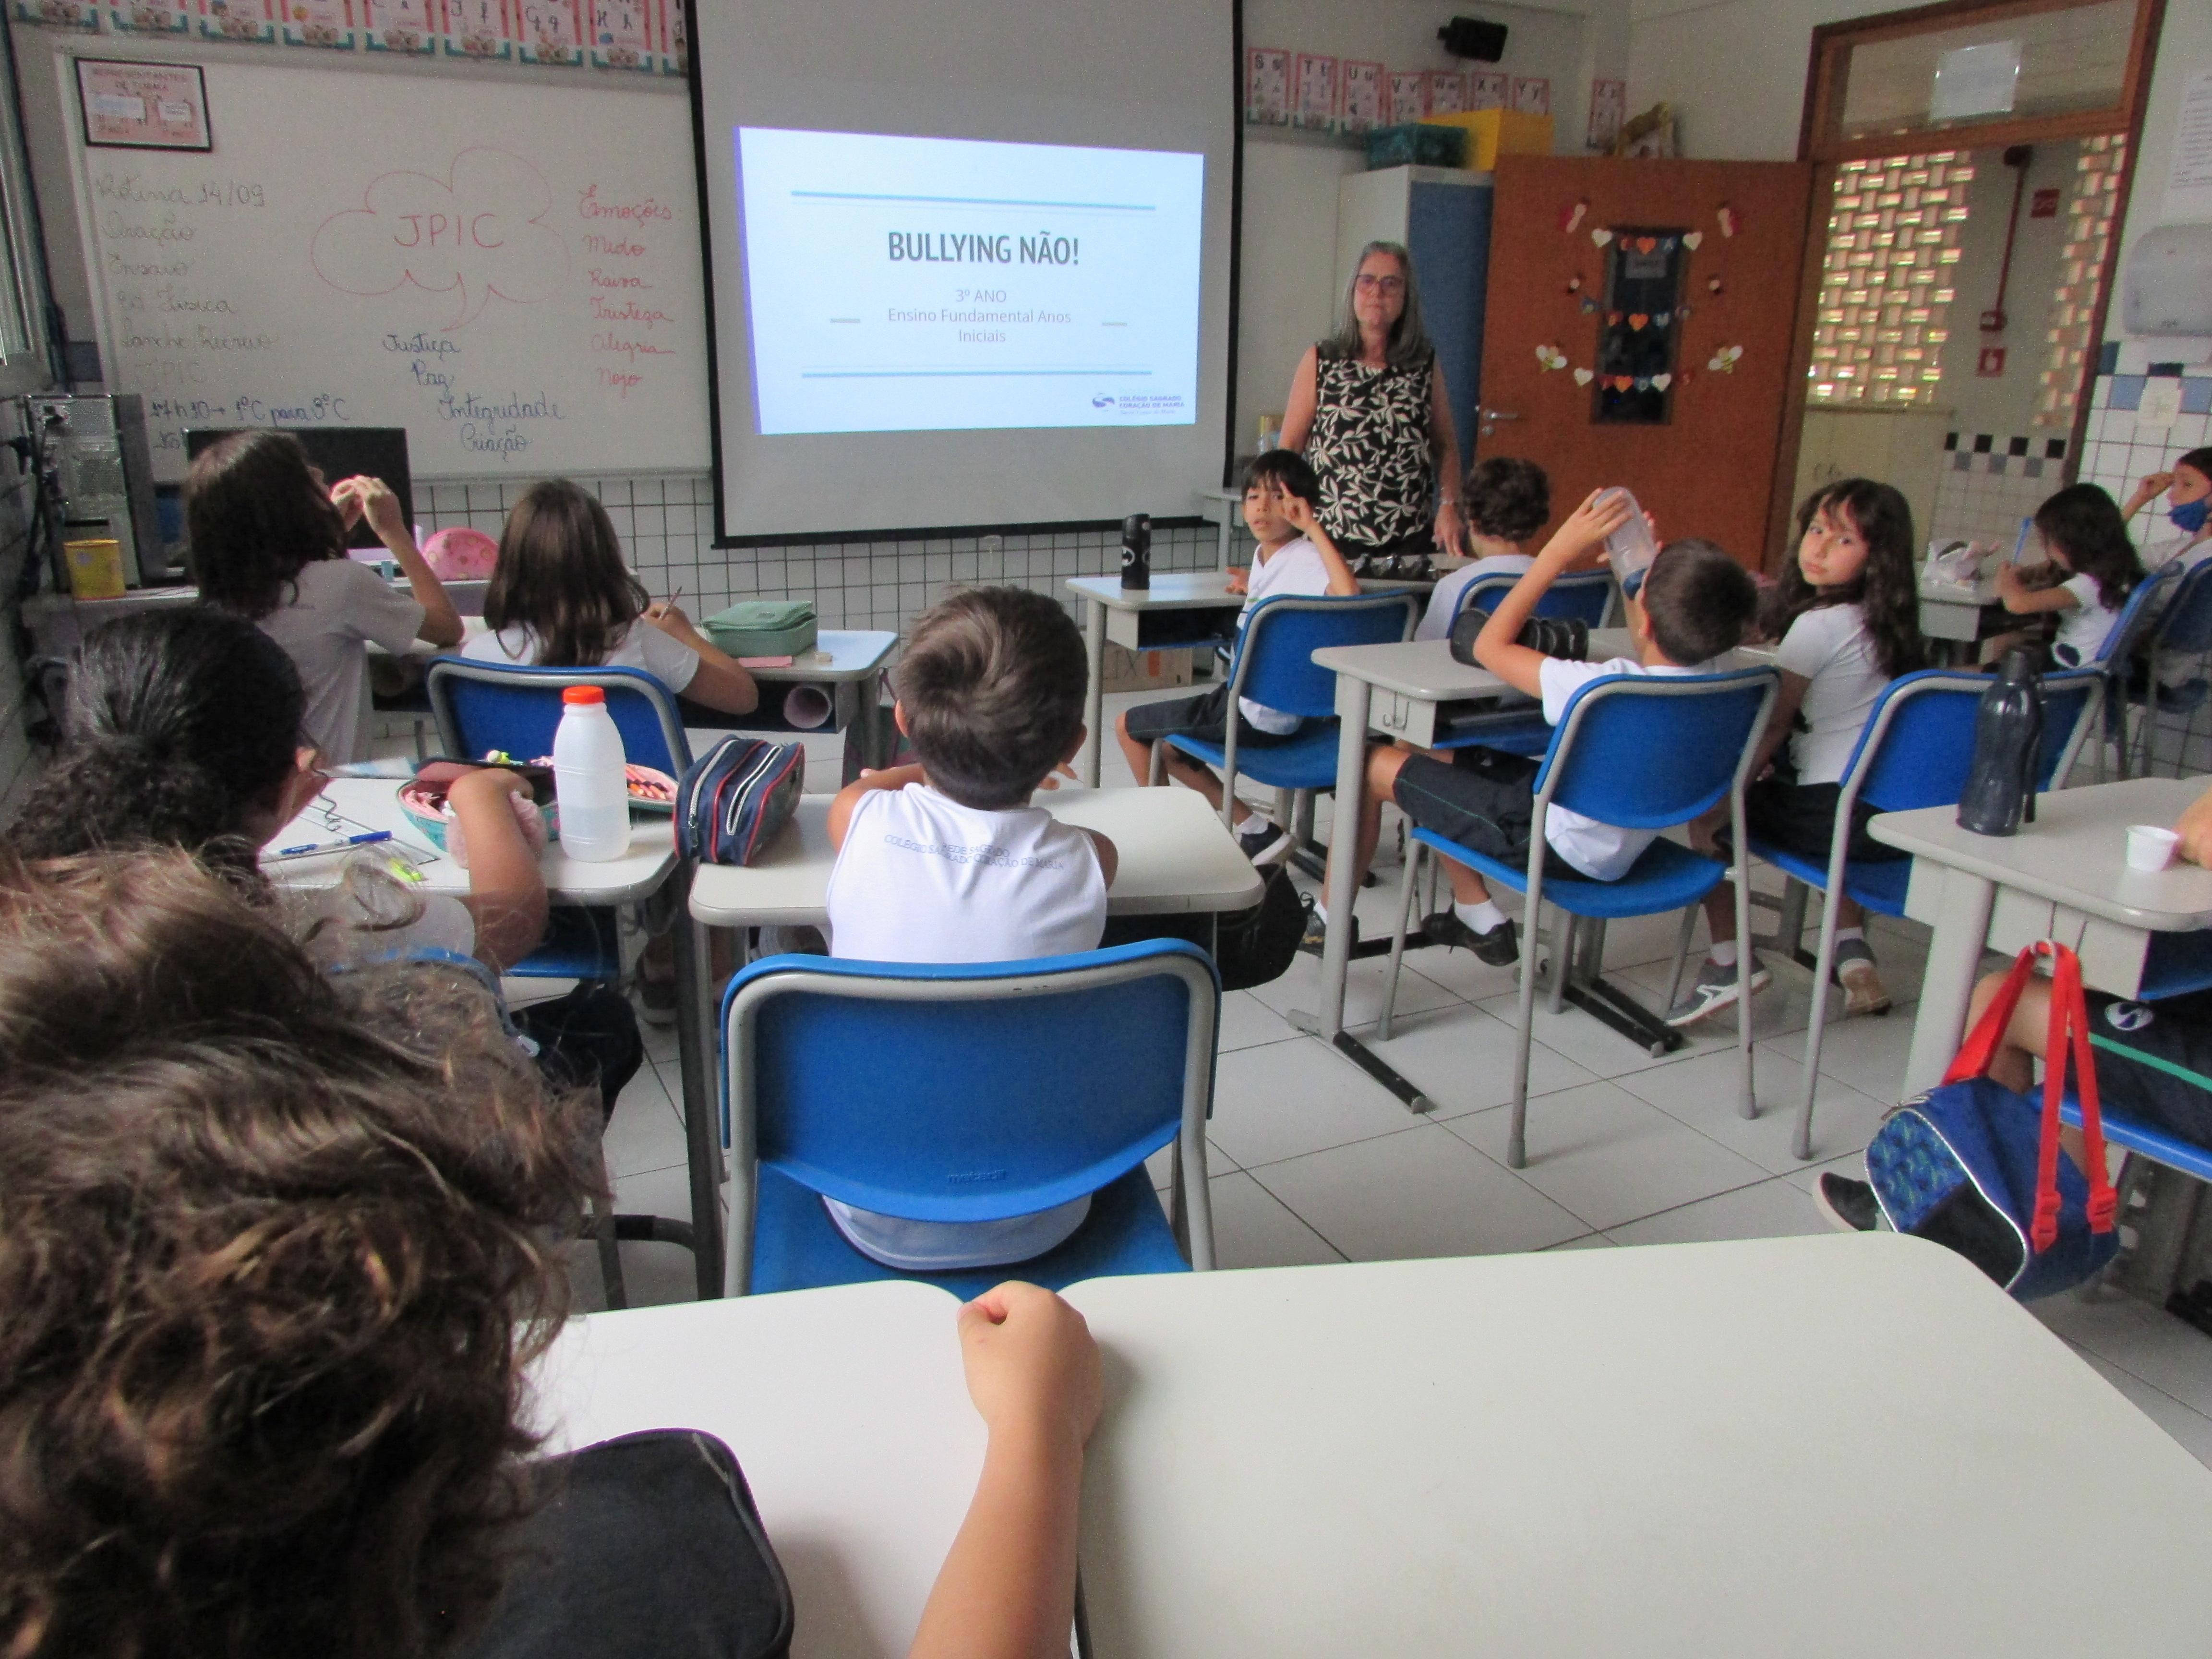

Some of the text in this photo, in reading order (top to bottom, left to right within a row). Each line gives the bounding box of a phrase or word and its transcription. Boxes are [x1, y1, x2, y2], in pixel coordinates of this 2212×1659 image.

[393, 213, 504, 249] JPIC
[582, 234, 646, 256] Medo
[888, 230, 1080, 265] BULLYING NÃO!
[974, 290, 1007, 303] ANO
[589, 296, 674, 330] Tristeza
[889, 308, 1072, 324] Ensino Fundamental Anos
[959, 329, 1007, 342] Iniciais
[438, 390, 566, 435] Integridade
